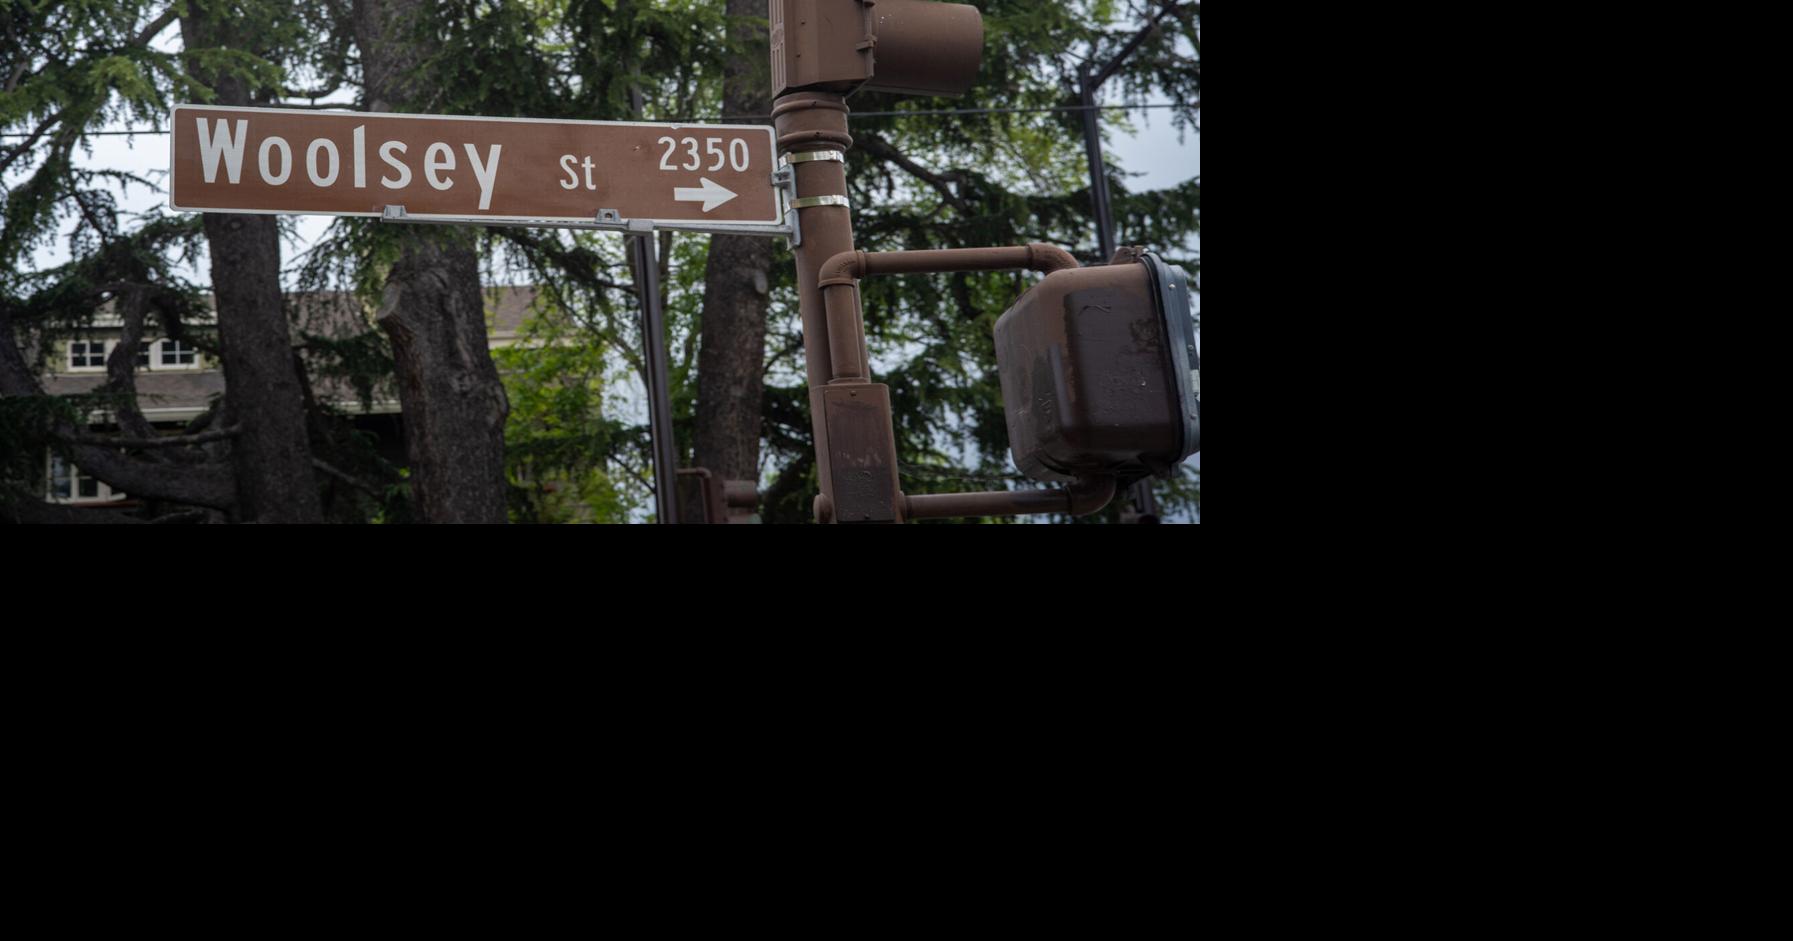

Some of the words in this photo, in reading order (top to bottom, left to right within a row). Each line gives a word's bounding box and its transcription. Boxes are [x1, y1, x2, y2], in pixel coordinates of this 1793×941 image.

[196, 117, 502, 210] Woolsey
[559, 154, 597, 191] St
[657, 136, 750, 172] 2350
